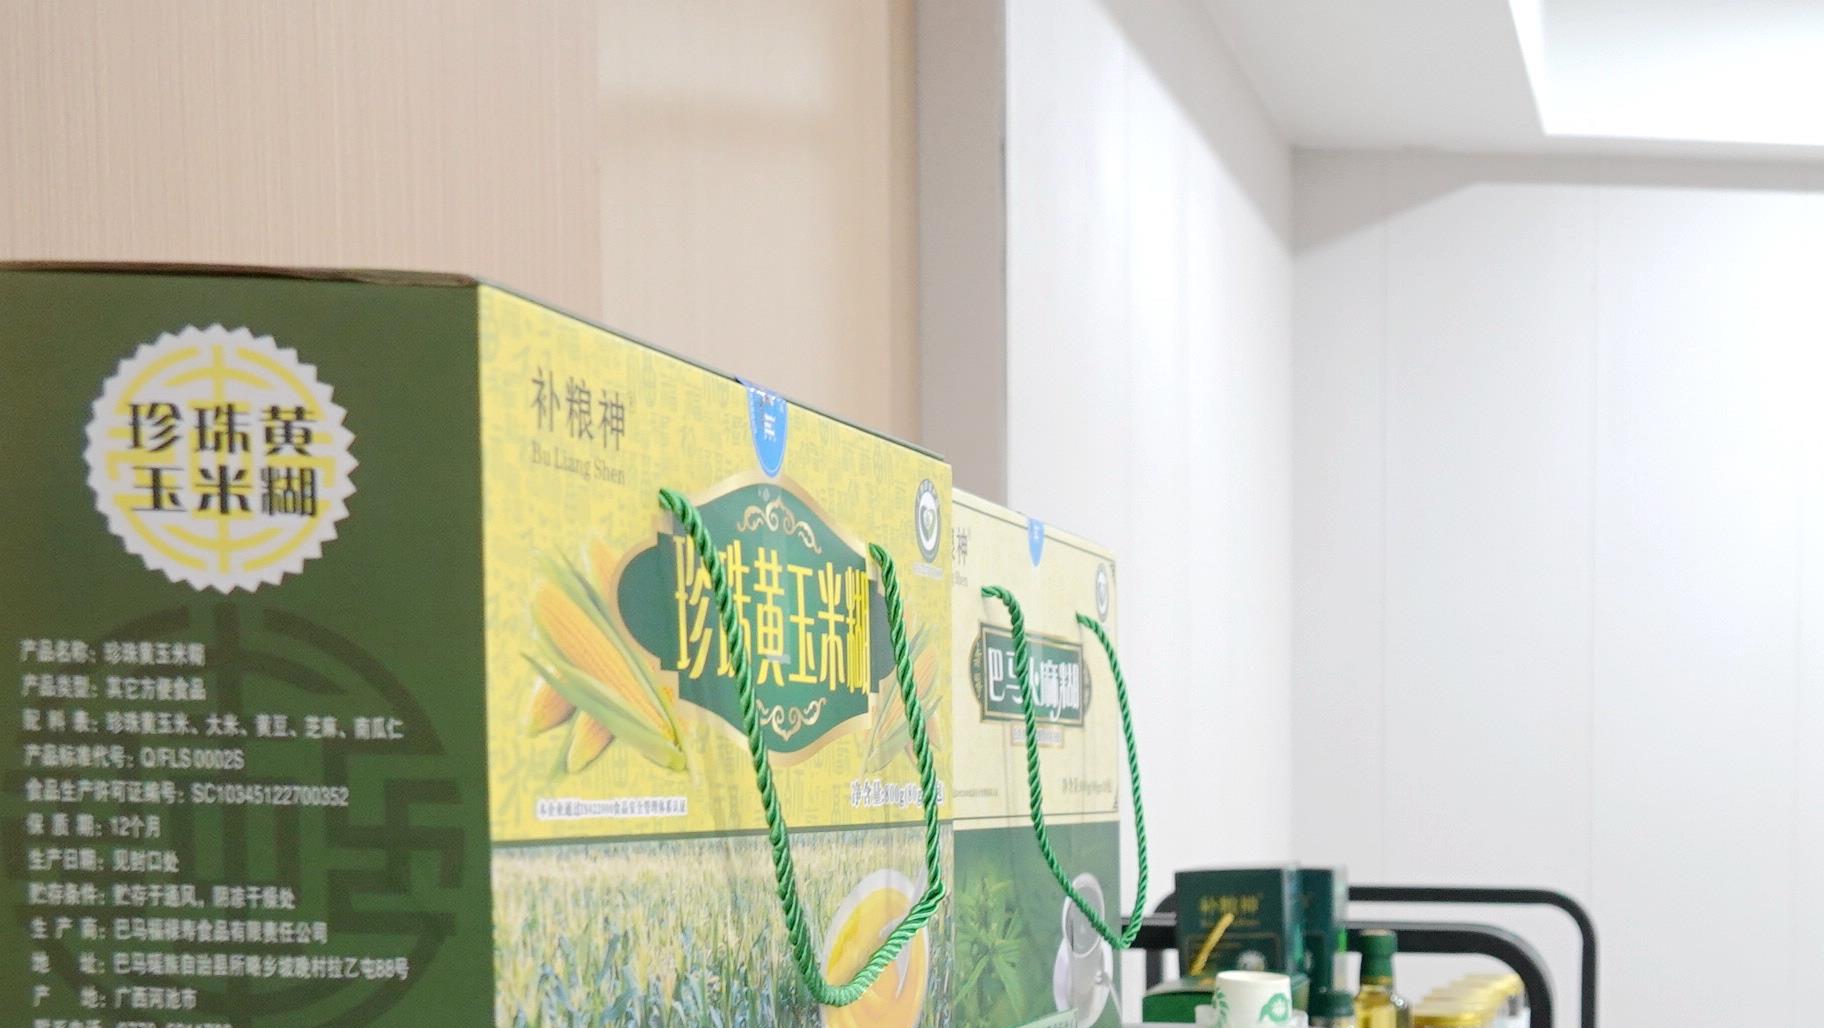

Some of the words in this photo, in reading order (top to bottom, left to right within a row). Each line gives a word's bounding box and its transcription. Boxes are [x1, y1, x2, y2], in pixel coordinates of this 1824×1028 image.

[128, 402, 316, 457] 珍珠黄
[531, 366, 625, 451] 补粮神
[532, 440, 551, 466] Bu
[554, 446, 591, 482] Liang
[594, 456, 625, 486] Shen
[131, 465, 318, 518] 玉米糊
[673, 535, 870, 695] 珍珠黄玉米糊
